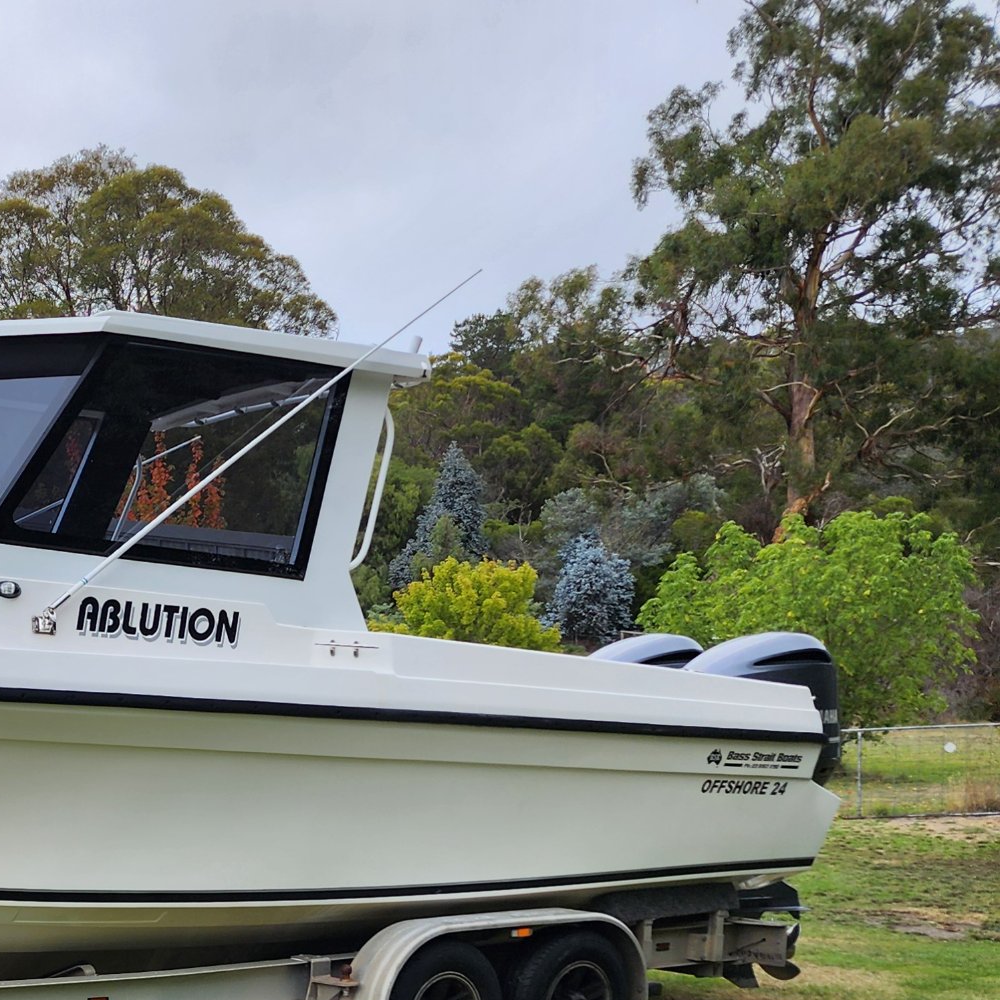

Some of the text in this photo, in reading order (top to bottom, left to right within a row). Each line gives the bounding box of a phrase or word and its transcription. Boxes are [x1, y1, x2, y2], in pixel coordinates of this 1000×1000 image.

[76, 596, 241, 648] ABLUTION
[726, 750, 751, 761] Bass
[777, 753, 803, 763] Boats
[701, 779, 788, 796] OFFSHORE 24
